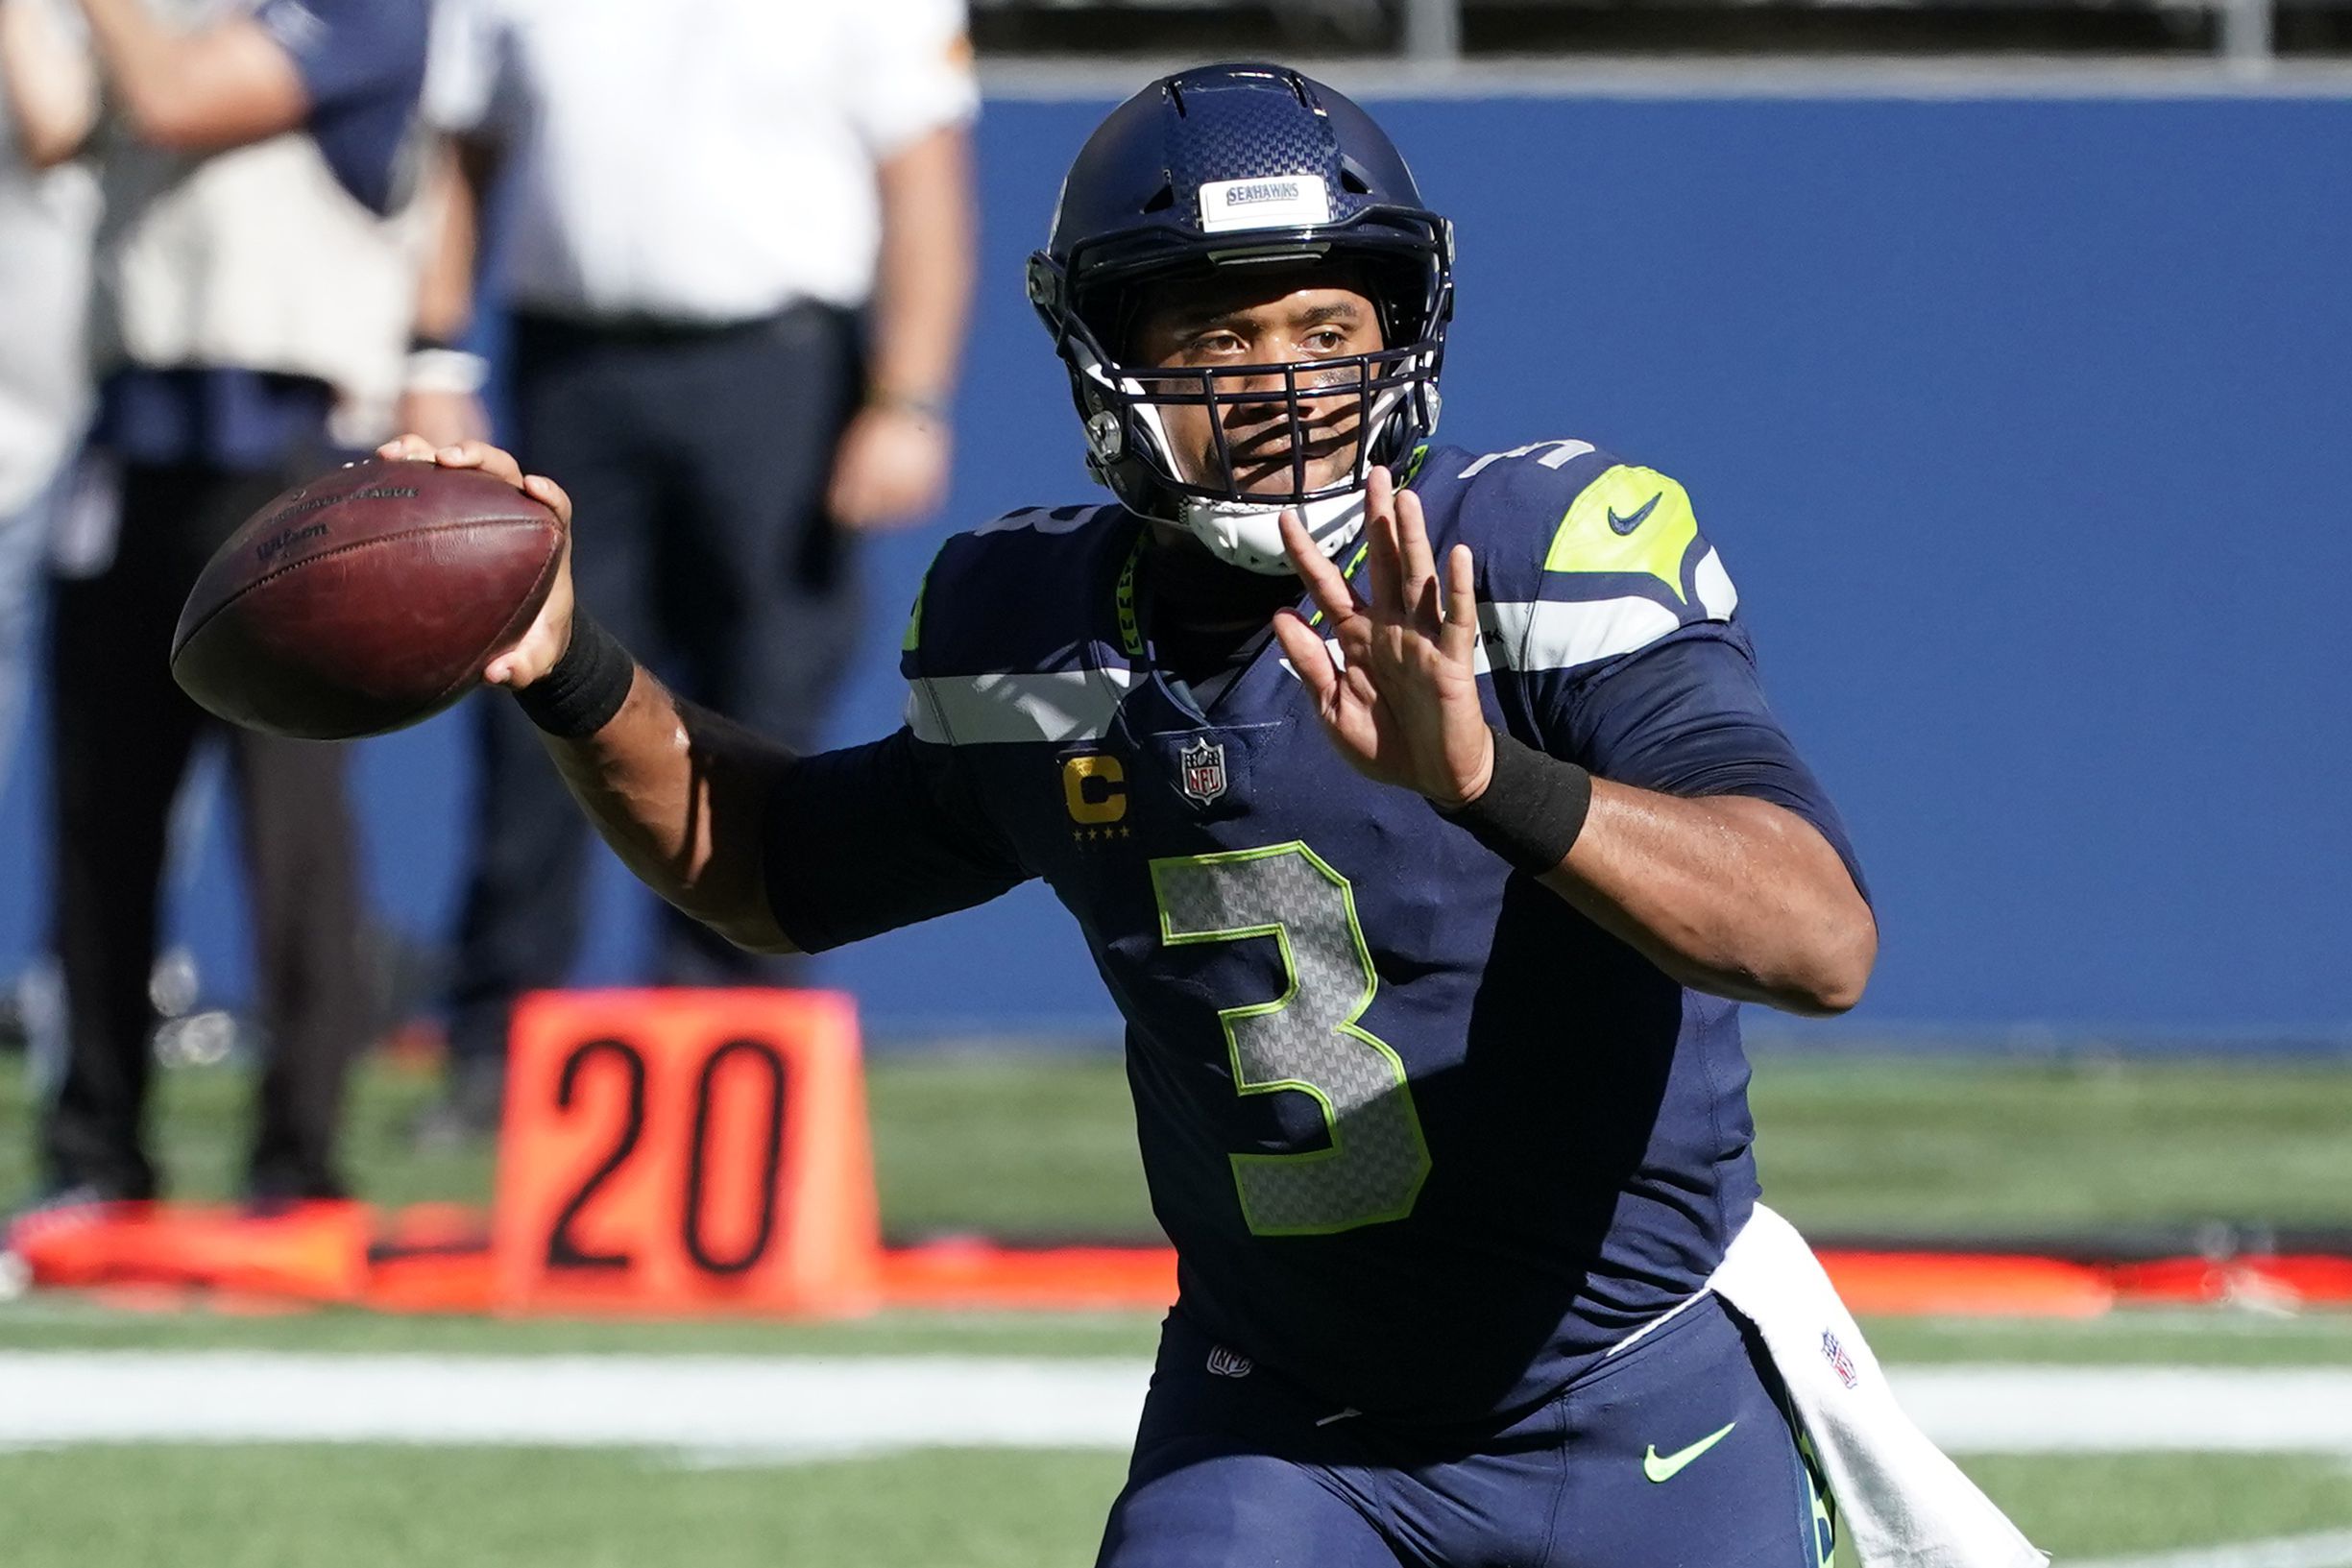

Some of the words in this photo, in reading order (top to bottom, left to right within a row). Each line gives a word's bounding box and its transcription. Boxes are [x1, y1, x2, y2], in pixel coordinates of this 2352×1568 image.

[1227, 182, 1299, 205] SEAHAWKS
[255, 523, 328, 561] Wilson
[1062, 756, 1128, 825] C
[1189, 768, 1220, 794] NFL
[1149, 839, 1433, 1237] 3
[547, 1038, 785, 1274] 20
